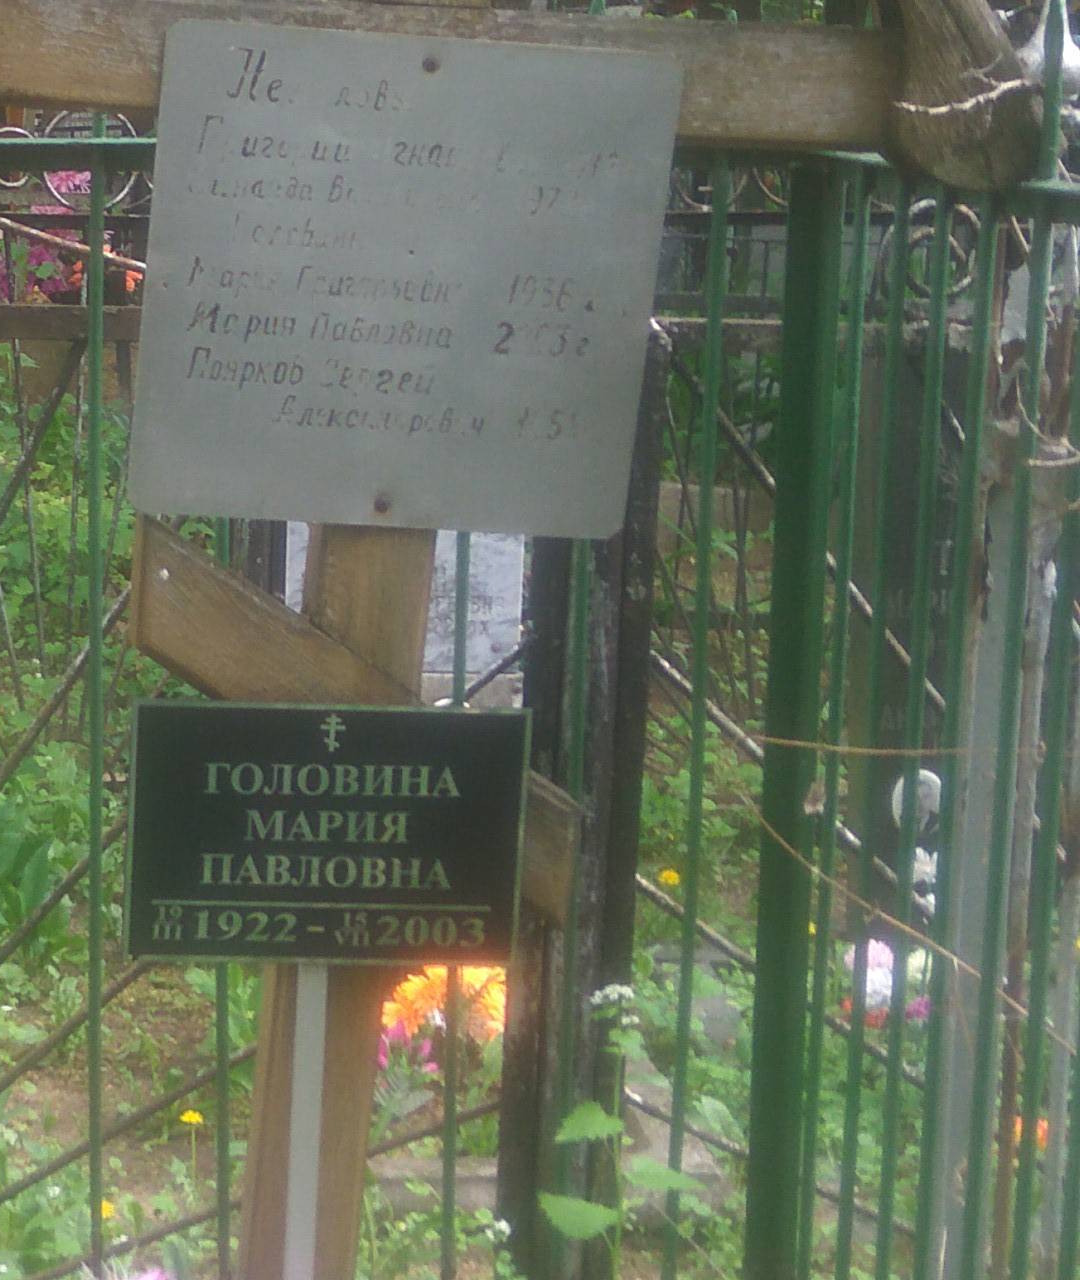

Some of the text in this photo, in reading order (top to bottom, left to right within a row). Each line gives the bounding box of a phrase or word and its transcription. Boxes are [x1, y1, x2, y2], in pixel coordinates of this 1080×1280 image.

[205, 761, 461, 798] ГОЛОВИНА
[243, 808, 410, 844] МАРИЯ
[200, 852, 452, 890] ПАВЛОВНА
[194, 909, 297, 943] 1922
[375, 914, 486, 948] 2003
